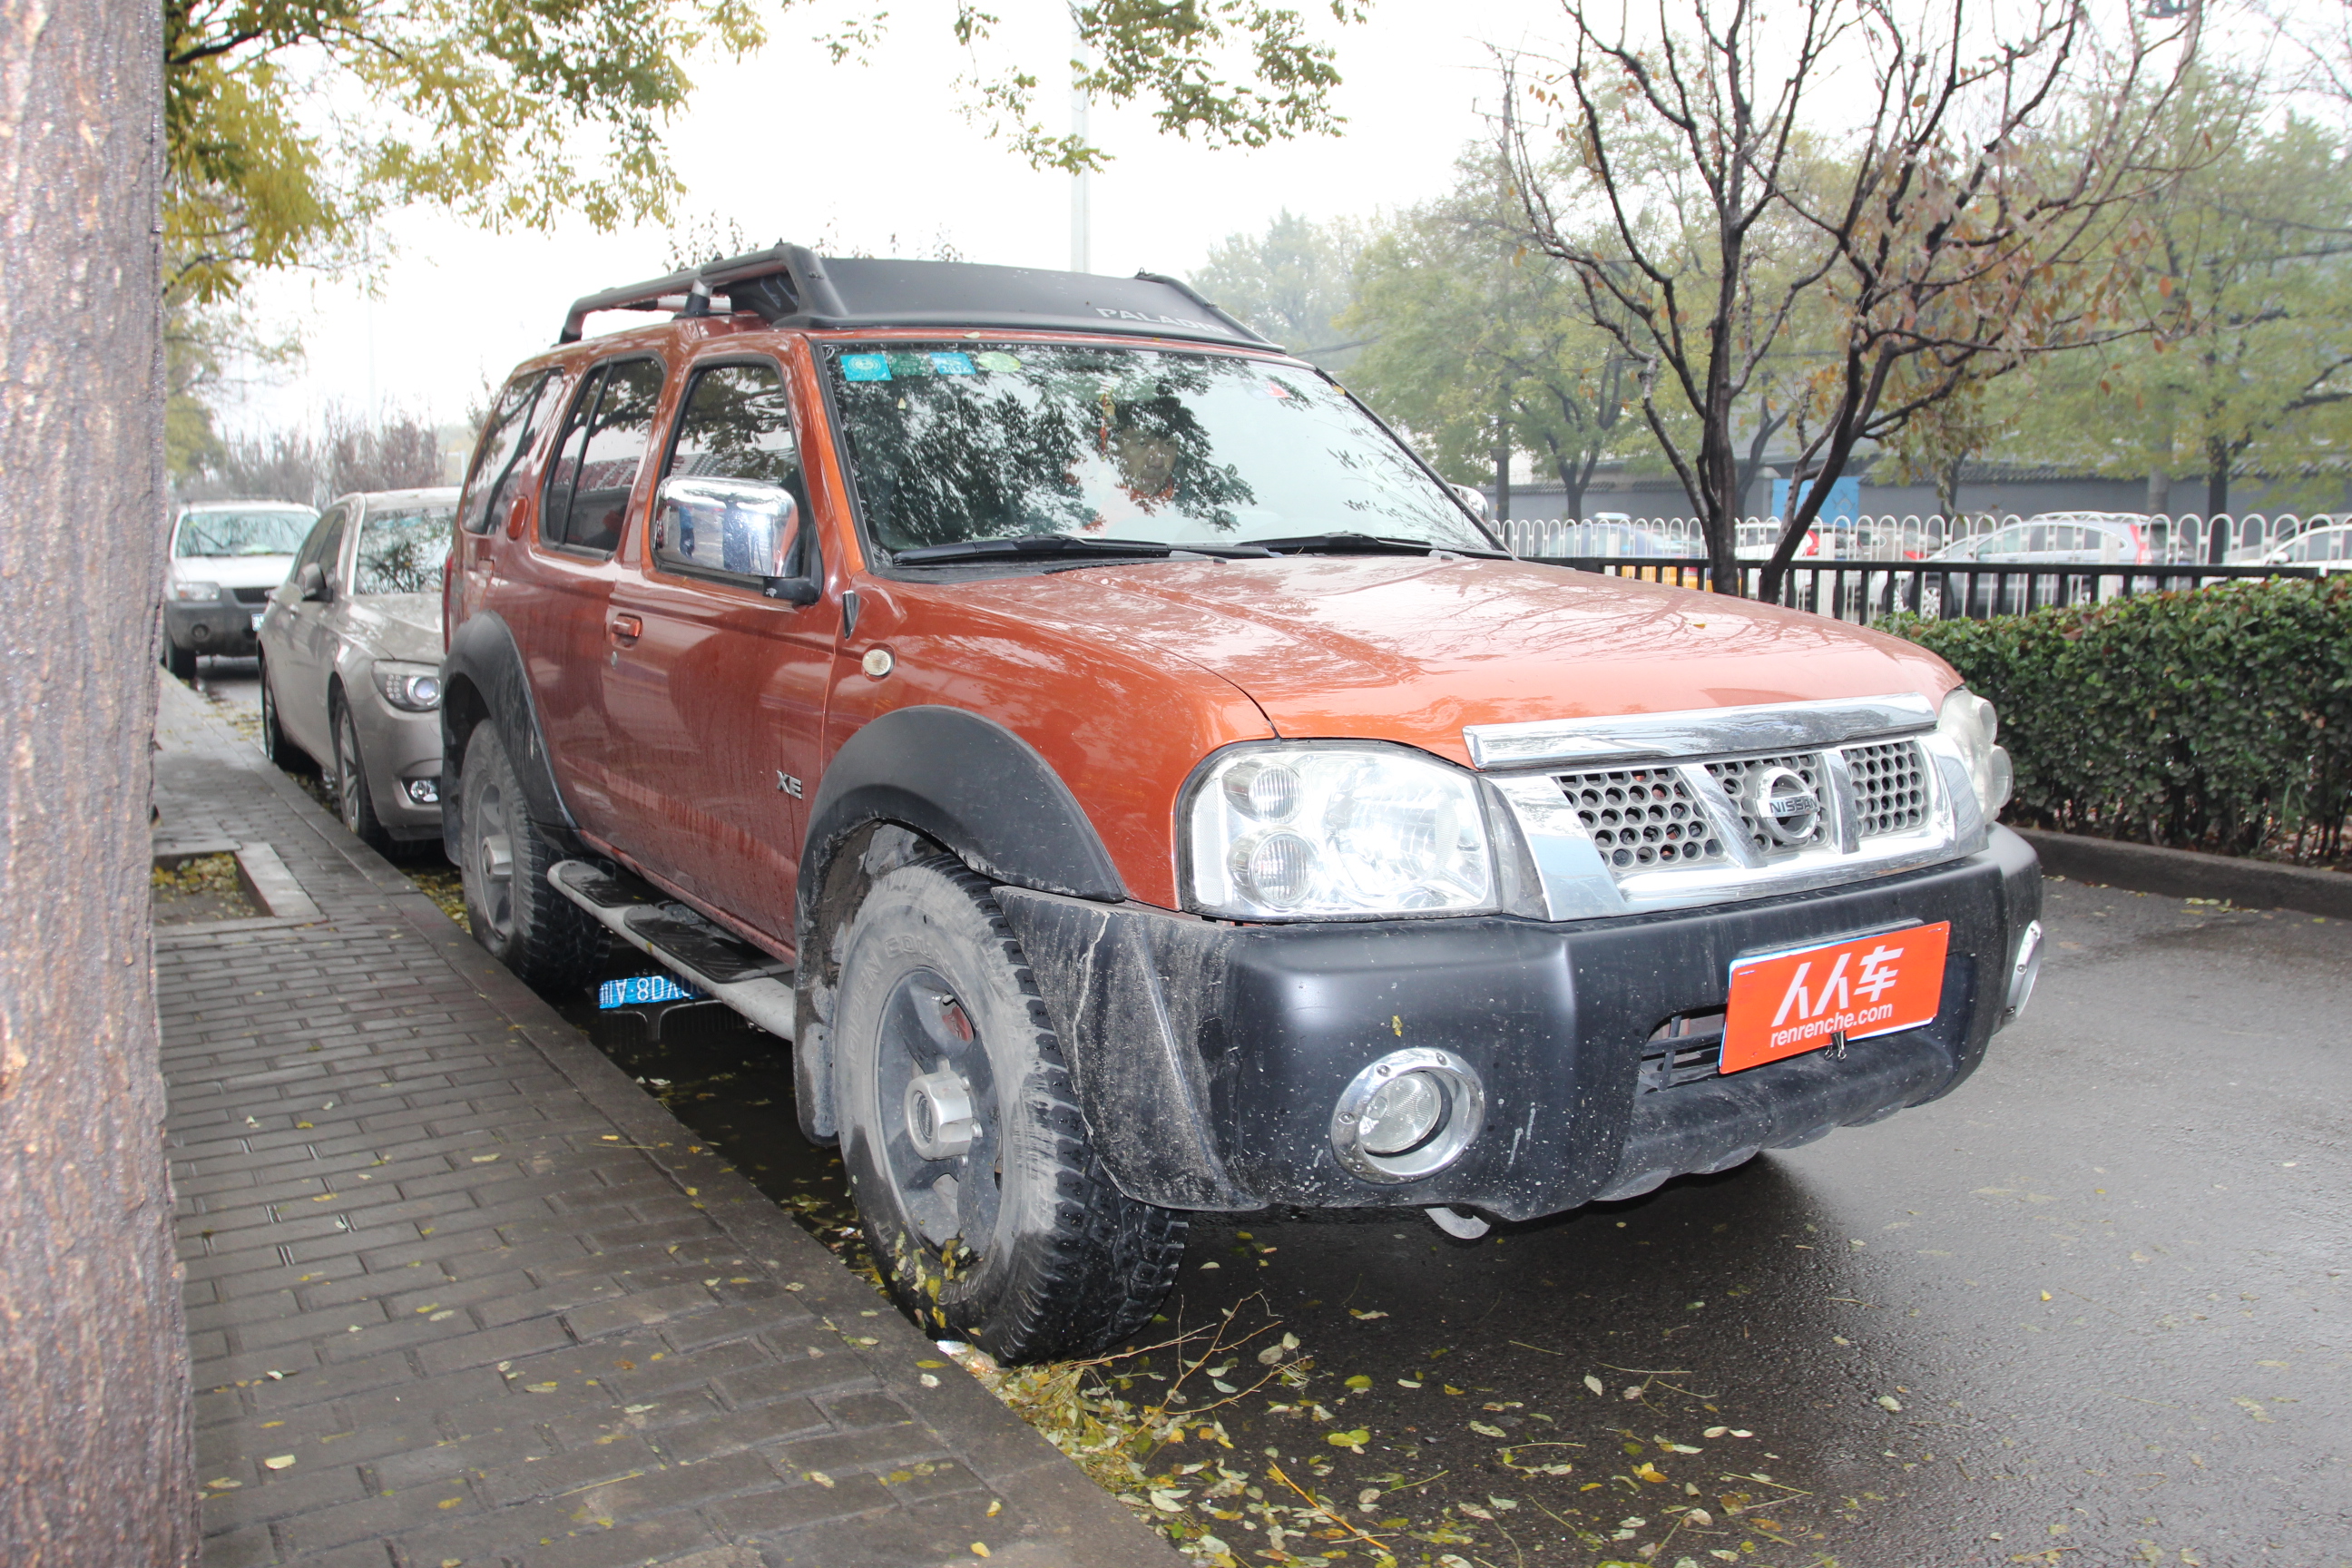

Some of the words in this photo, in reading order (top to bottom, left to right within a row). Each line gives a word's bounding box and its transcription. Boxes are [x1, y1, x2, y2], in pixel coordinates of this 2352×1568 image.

[1095, 307, 1233, 336] PALADIN
[776, 769, 802, 799] XE
[1769, 799, 1818, 814] NISSAN
[1770, 946, 1904, 1028] 人人车
[1770, 1003, 1893, 1048] renrenche.com
